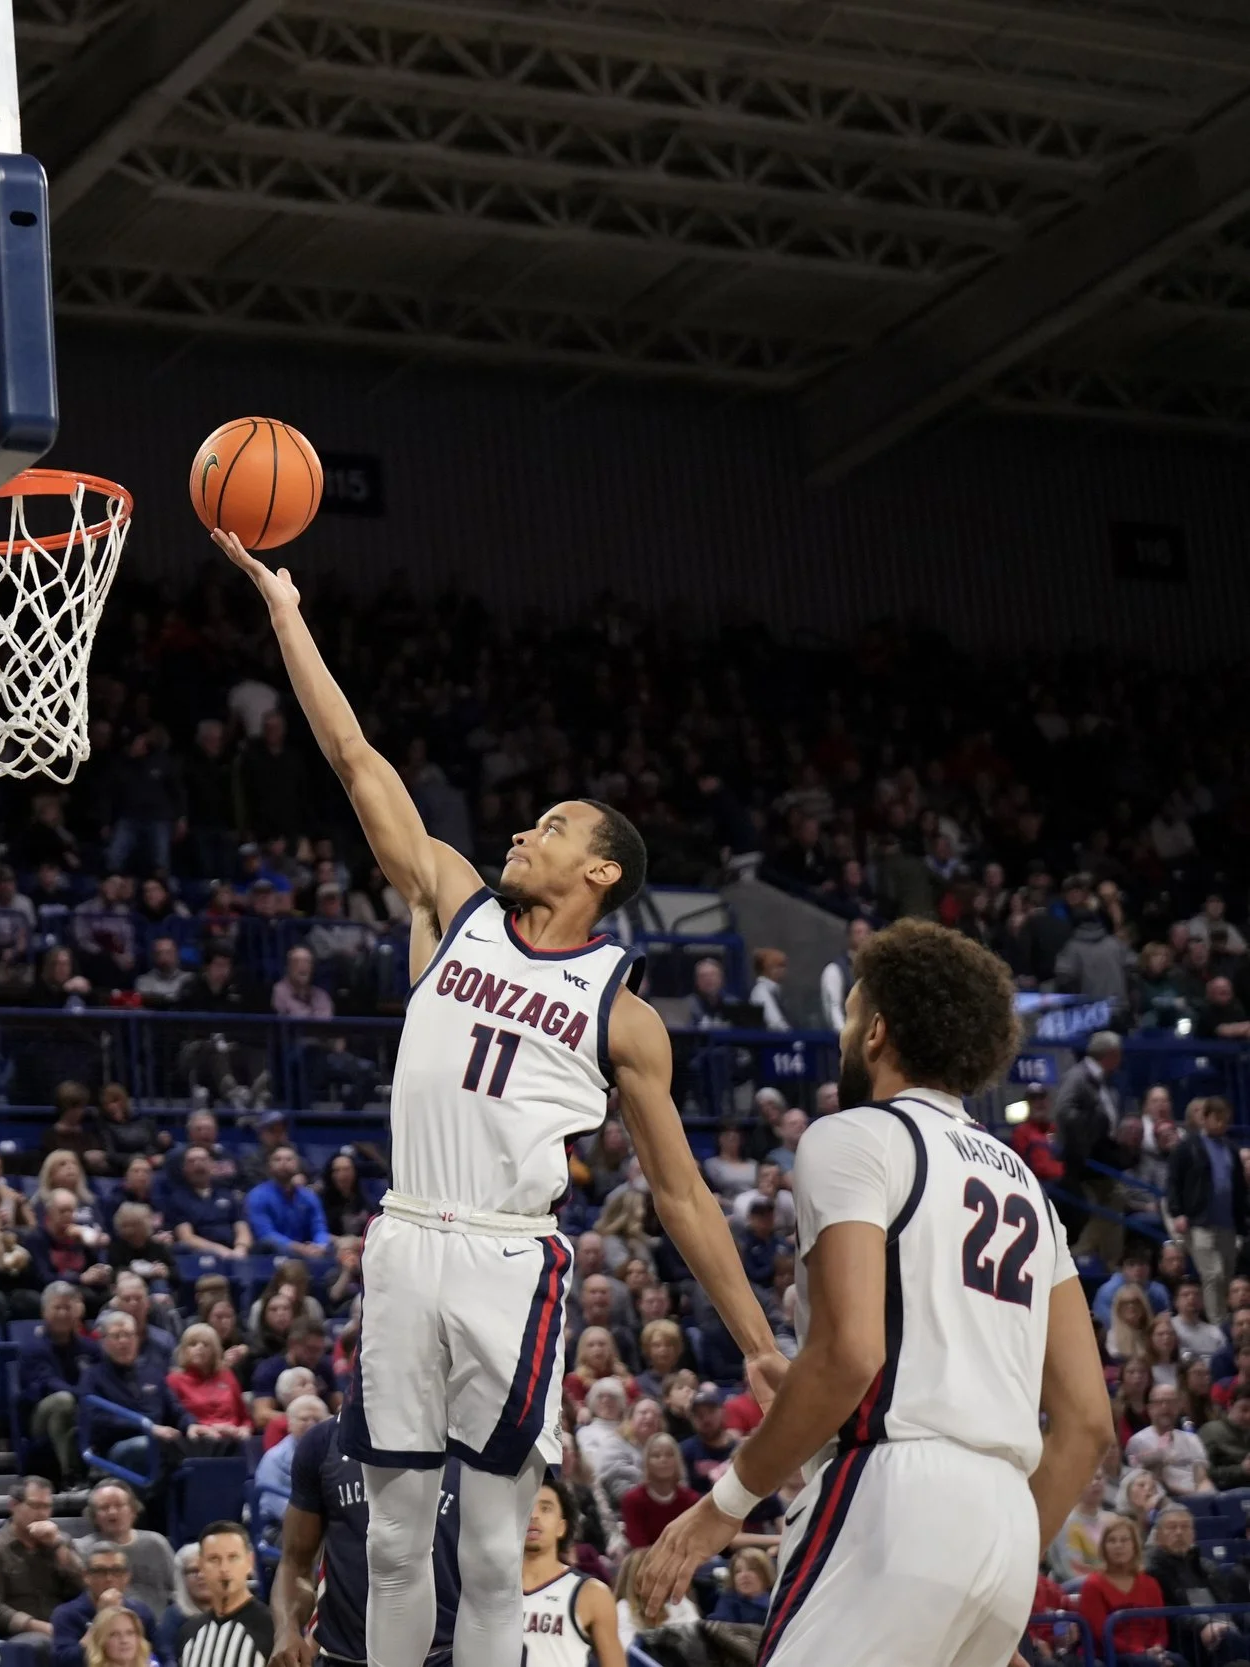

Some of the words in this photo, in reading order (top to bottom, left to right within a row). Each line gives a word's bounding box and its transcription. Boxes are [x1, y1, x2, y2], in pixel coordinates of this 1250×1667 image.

[436, 960, 589, 1052] GONZAGA
[563, 969, 590, 992] WCC
[462, 1023, 522, 1099] 11
[773, 1052, 806, 1076] 114
[945, 1131, 1030, 1190] WATSON
[962, 1176, 1039, 1313] 22
[523, 1611, 564, 1636] AGA
